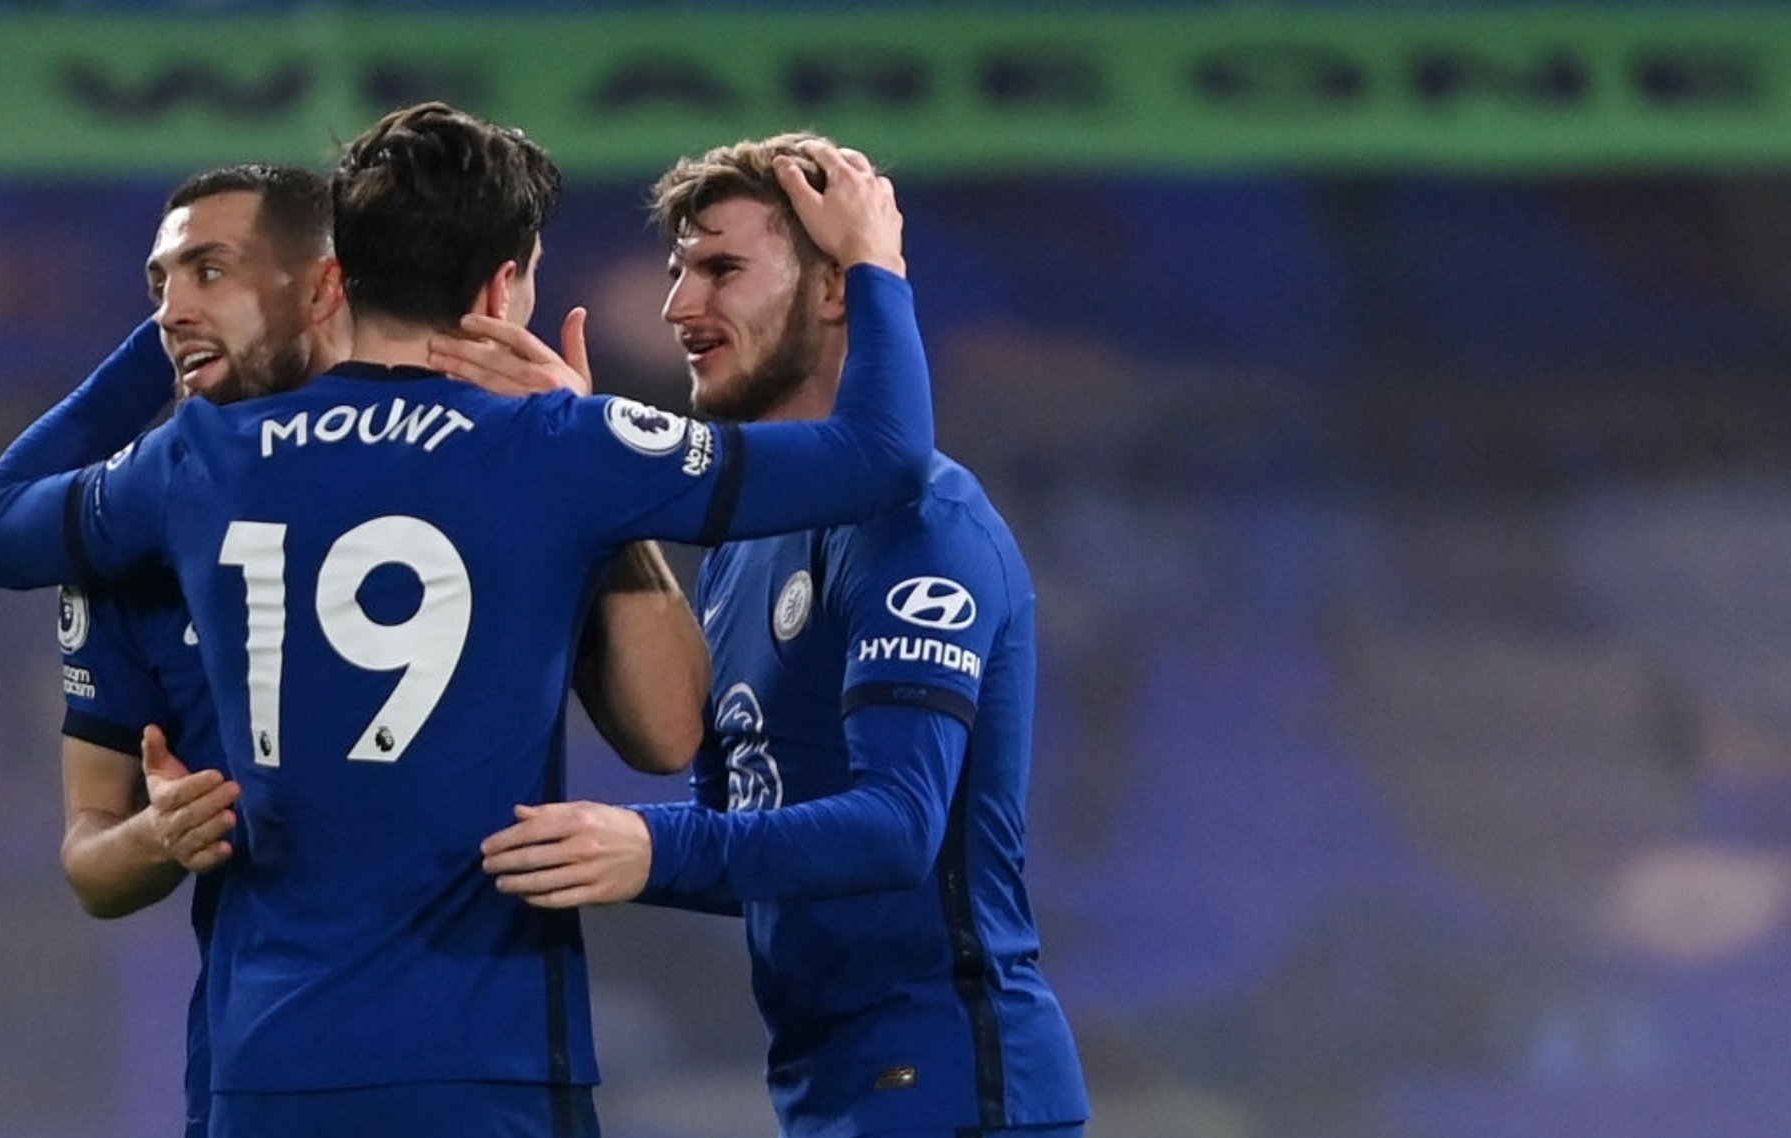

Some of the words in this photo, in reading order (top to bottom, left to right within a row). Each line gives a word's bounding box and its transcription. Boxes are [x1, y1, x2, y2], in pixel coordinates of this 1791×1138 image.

[1184, 45, 1769, 115] ONE
[261, 397, 475, 458] MOUNT
[218, 515, 472, 768] 19
[858, 636, 981, 679] HYUNDAI
